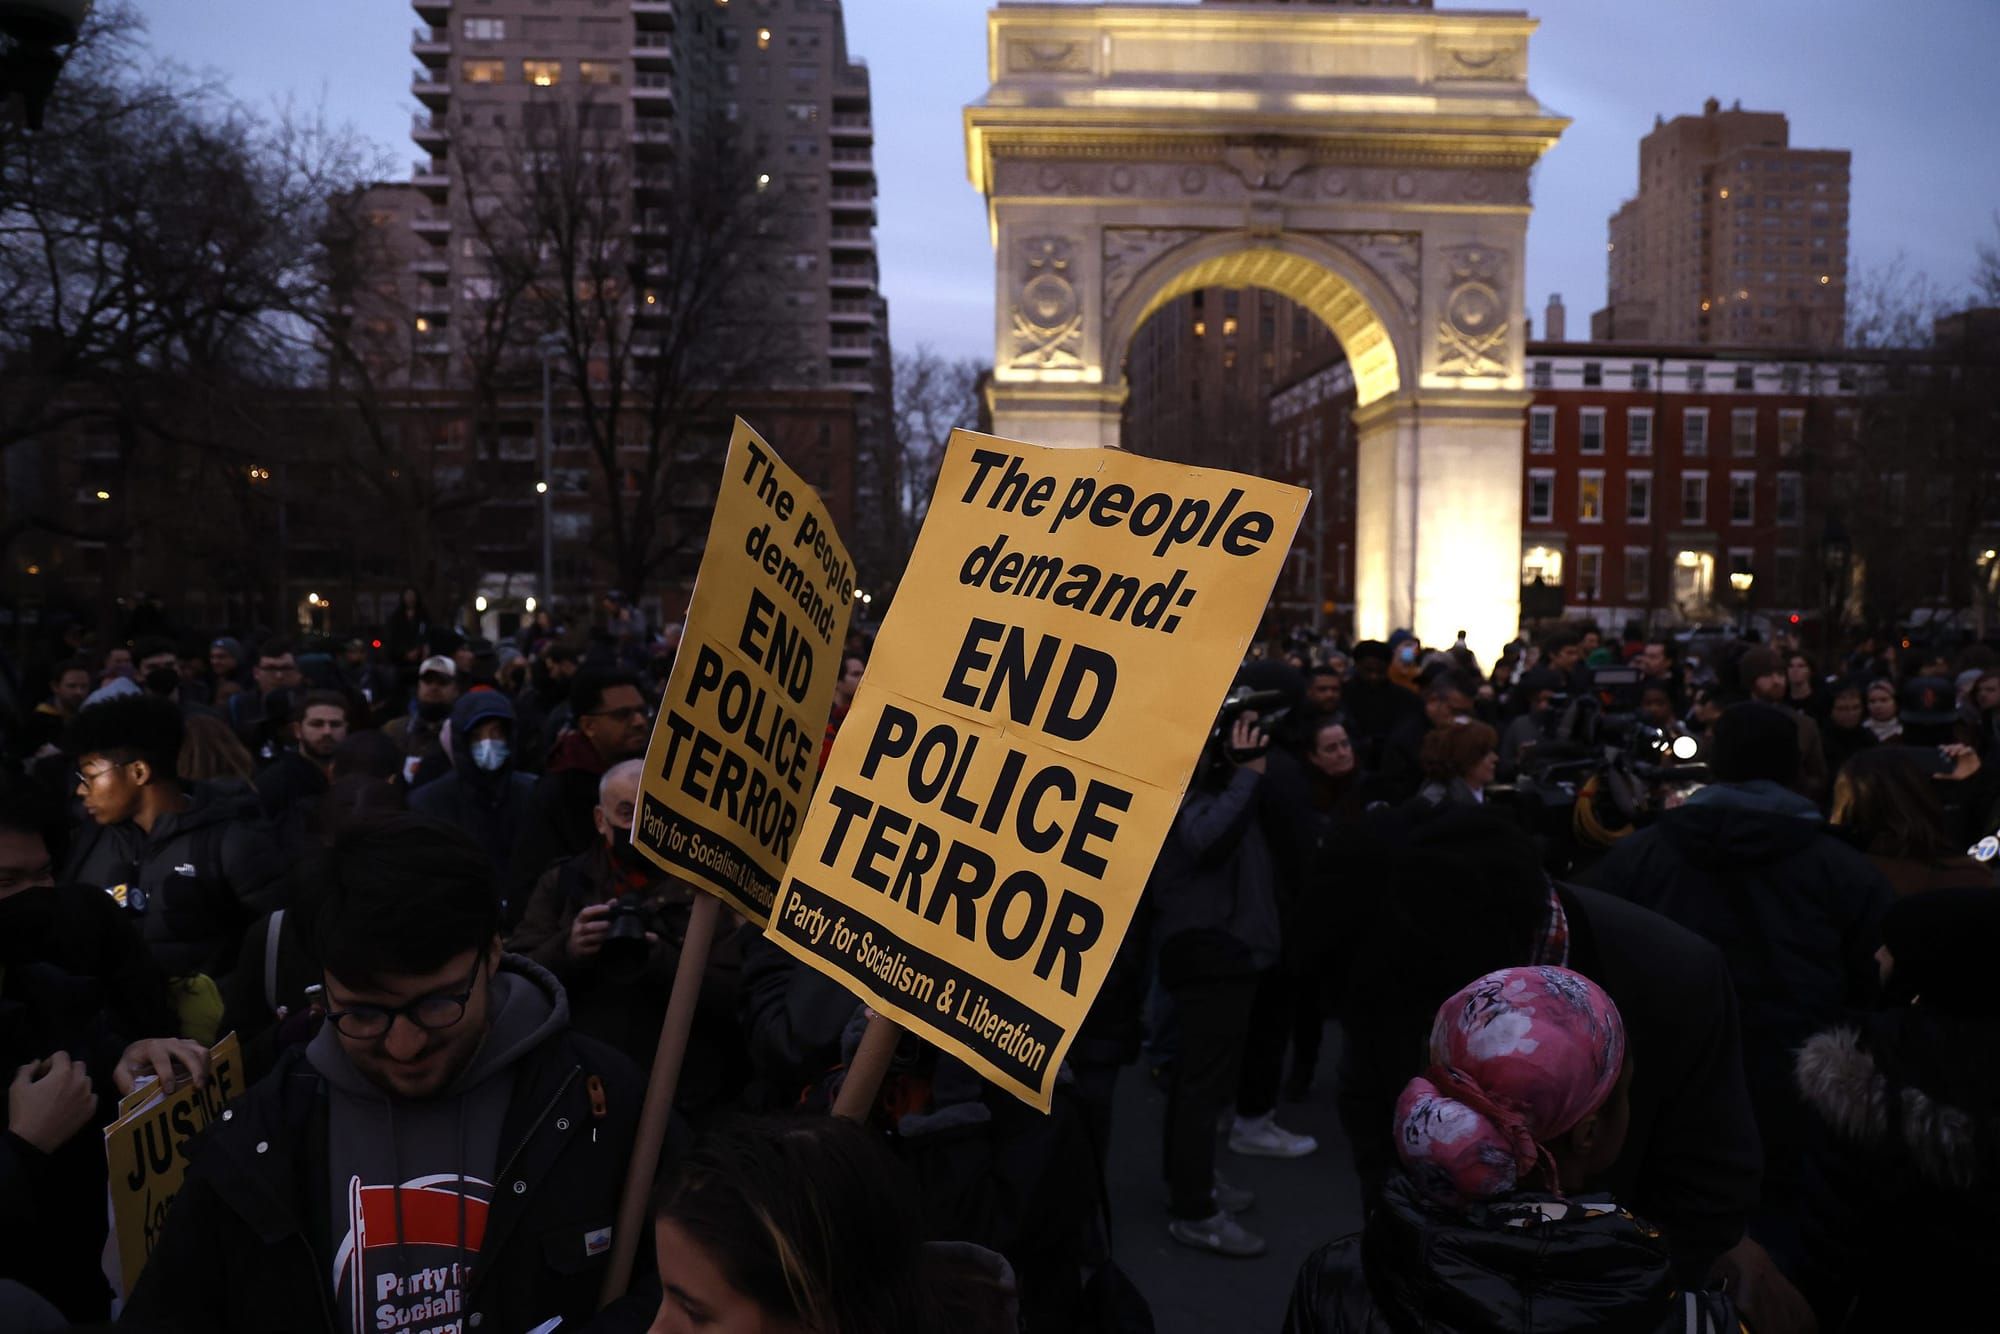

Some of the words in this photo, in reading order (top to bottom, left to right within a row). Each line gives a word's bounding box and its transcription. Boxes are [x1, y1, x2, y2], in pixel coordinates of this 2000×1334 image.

[743, 441, 794, 521] The
[794, 512, 851, 605] people
[961, 449, 1056, 517] The
[1049, 477, 1274, 557] people
[739, 587, 812, 703] END
[746, 524, 834, 644] demand:
[959, 534, 1196, 634] demand:
[685, 643, 812, 794] POLICE
[942, 617, 1117, 741] END
[661, 709, 797, 865] TERROR
[860, 704, 1133, 880] POLICE
[643, 803, 668, 848] Party
[667, 823, 688, 853] for
[688, 833, 740, 884] Socialism
[738, 863, 747, 888] &
[744, 867, 773, 908] Liberatio
[820, 785, 1104, 997] TERROR
[784, 891, 831, 945] Party
[829, 915, 859, 954] for
[856, 931, 935, 1003] Socialism
[936, 978, 956, 1015] &
[955, 988, 1047, 1072] Liberation
[376, 1289, 462, 1330] Sociali
